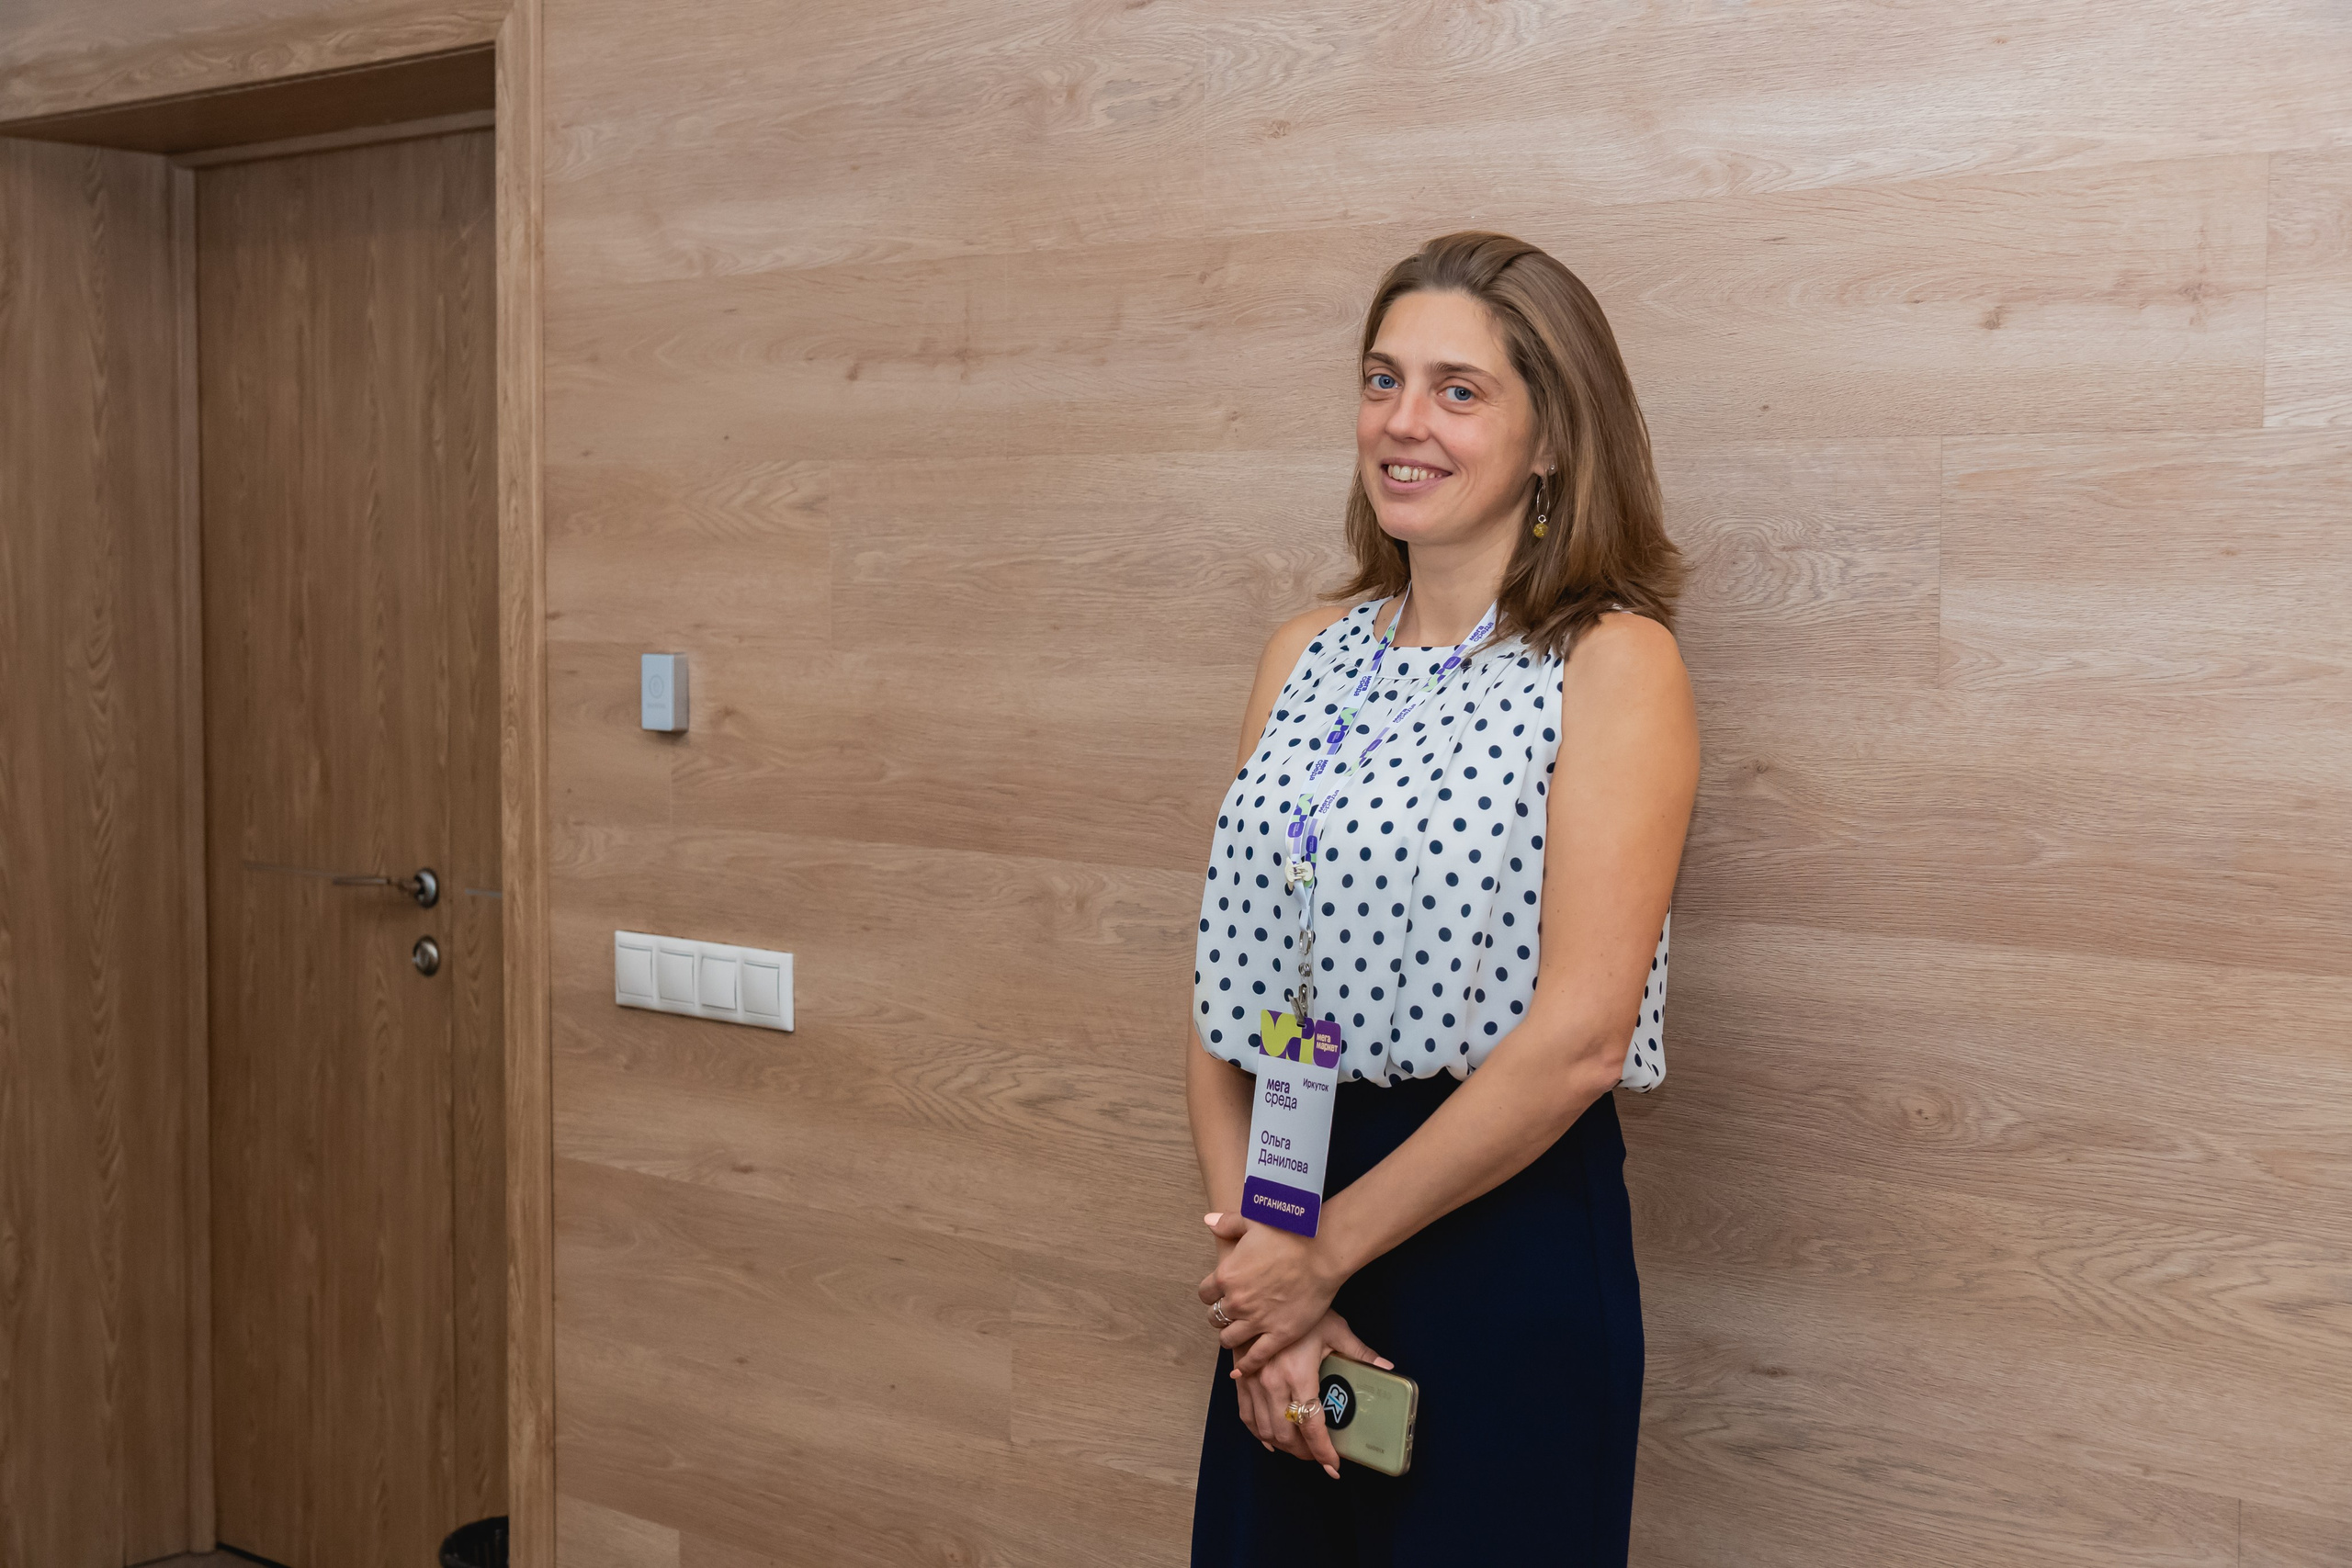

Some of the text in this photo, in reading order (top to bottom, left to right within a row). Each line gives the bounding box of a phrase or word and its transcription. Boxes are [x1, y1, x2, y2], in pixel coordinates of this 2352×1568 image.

[1316, 1032, 1331, 1043] мега
[1316, 1041, 1339, 1053] маркет
[1266, 1077, 1291, 1094] мега
[1303, 1077, 1329, 1092] Иркутск
[1264, 1091, 1297, 1111] среда
[1261, 1130, 1291, 1150] Ольга
[1258, 1148, 1309, 1174] Данилова
[1253, 1194, 1306, 1217] ОРГАНИЗАТОР
